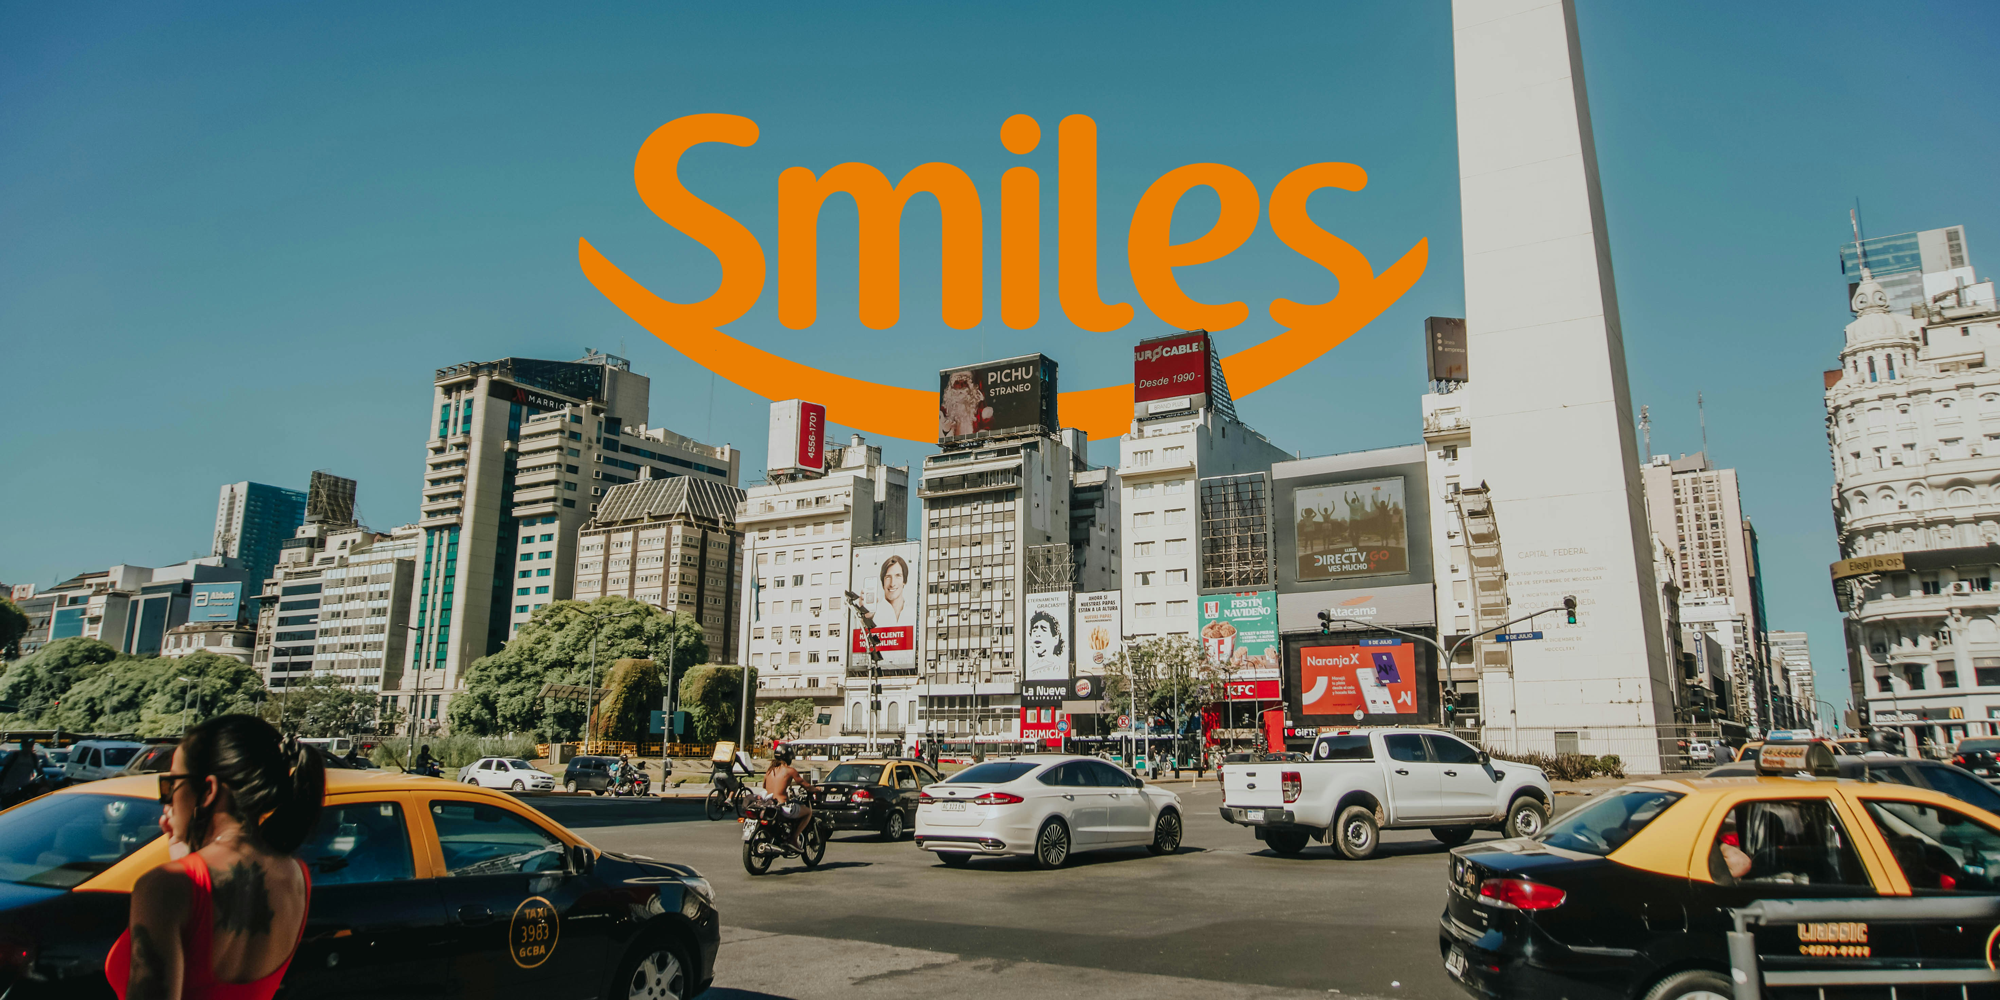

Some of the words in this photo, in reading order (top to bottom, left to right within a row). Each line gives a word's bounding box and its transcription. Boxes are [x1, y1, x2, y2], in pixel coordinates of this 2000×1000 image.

[988, 365, 1033, 385] PICHU
[1139, 376, 1169, 389] Desde
[1173, 372, 1195, 383] 1990
[990, 383, 1031, 397] STRANEO
[528, 394, 566, 410] MARRIO
[808, 412, 817, 459] 4556-1701
[1314, 552, 1367, 566] DIRECTV
[1369, 550, 1389, 560] GO
[1518, 550, 1549, 559] CAPITAL
[1553, 547, 1589, 556] FEDERAL
[1342, 563, 1367, 571] MUCHO
[210, 591, 235, 600] Abbott
[1231, 596, 1262, 608] FESTÍN
[1553, 599, 1596, 608] AVENEDA
[1224, 606, 1271, 617] NAVIDEÑO
[1330, 607, 1377, 616] Atacama
[880, 631, 905, 639] CLIENTE
[1022, 686, 1034, 696] La
[1036, 686, 1067, 696] Nueve
[1227, 685, 1255, 696] KFC
[1023, 729, 1065, 739] PRIMICIA
[524, 907, 548, 919] TAXI
[521, 923, 549, 943] 3983
[519, 945, 546, 957] GCBA
